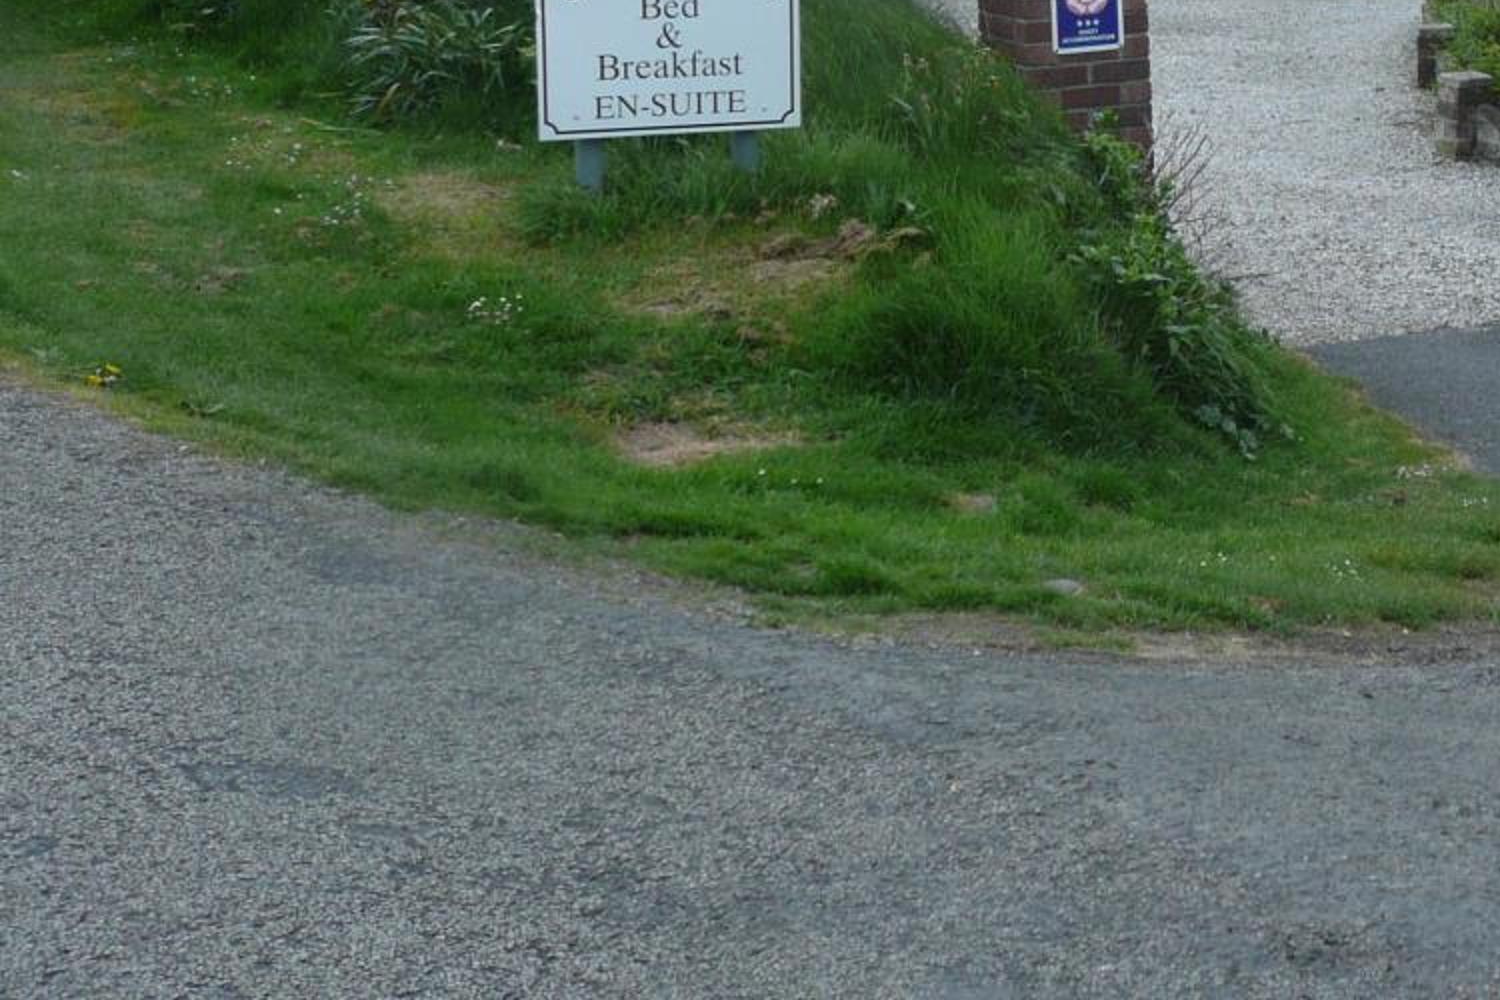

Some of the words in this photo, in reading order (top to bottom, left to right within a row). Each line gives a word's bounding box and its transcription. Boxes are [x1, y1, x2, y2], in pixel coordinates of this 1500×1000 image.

[655, 21, 683, 49] &
[597, 50, 743, 81] Breakfast
[594, 89, 747, 120] EN-SUITE
